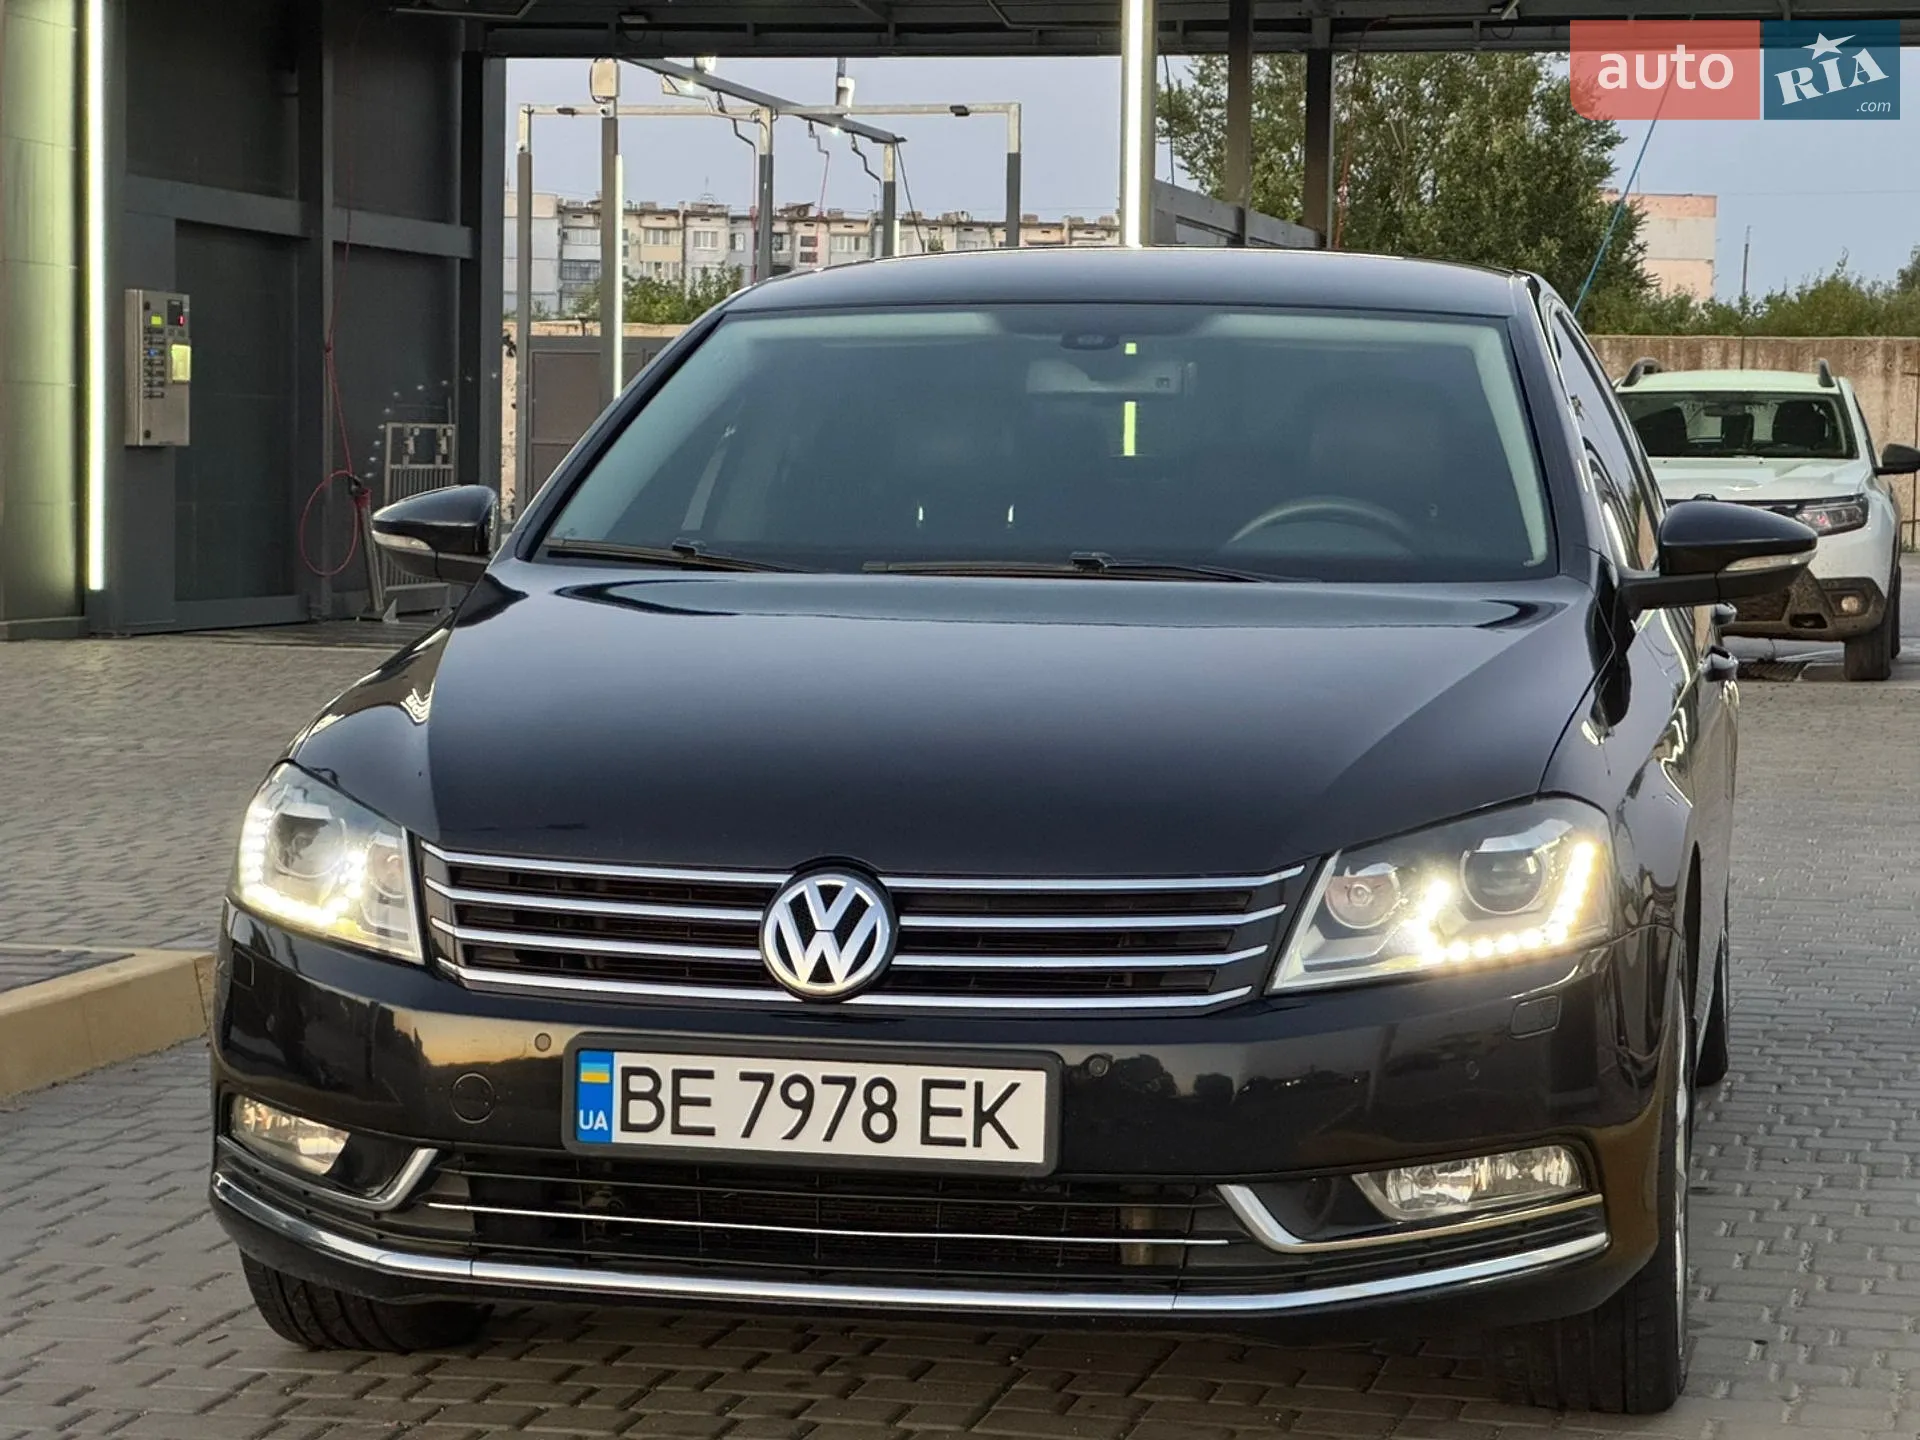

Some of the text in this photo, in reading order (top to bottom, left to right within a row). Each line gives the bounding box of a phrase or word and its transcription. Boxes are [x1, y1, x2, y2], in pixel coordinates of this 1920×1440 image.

[579, 1110, 608, 1132] UA
[620, 1066, 1022, 1150] BE 7978 EK
